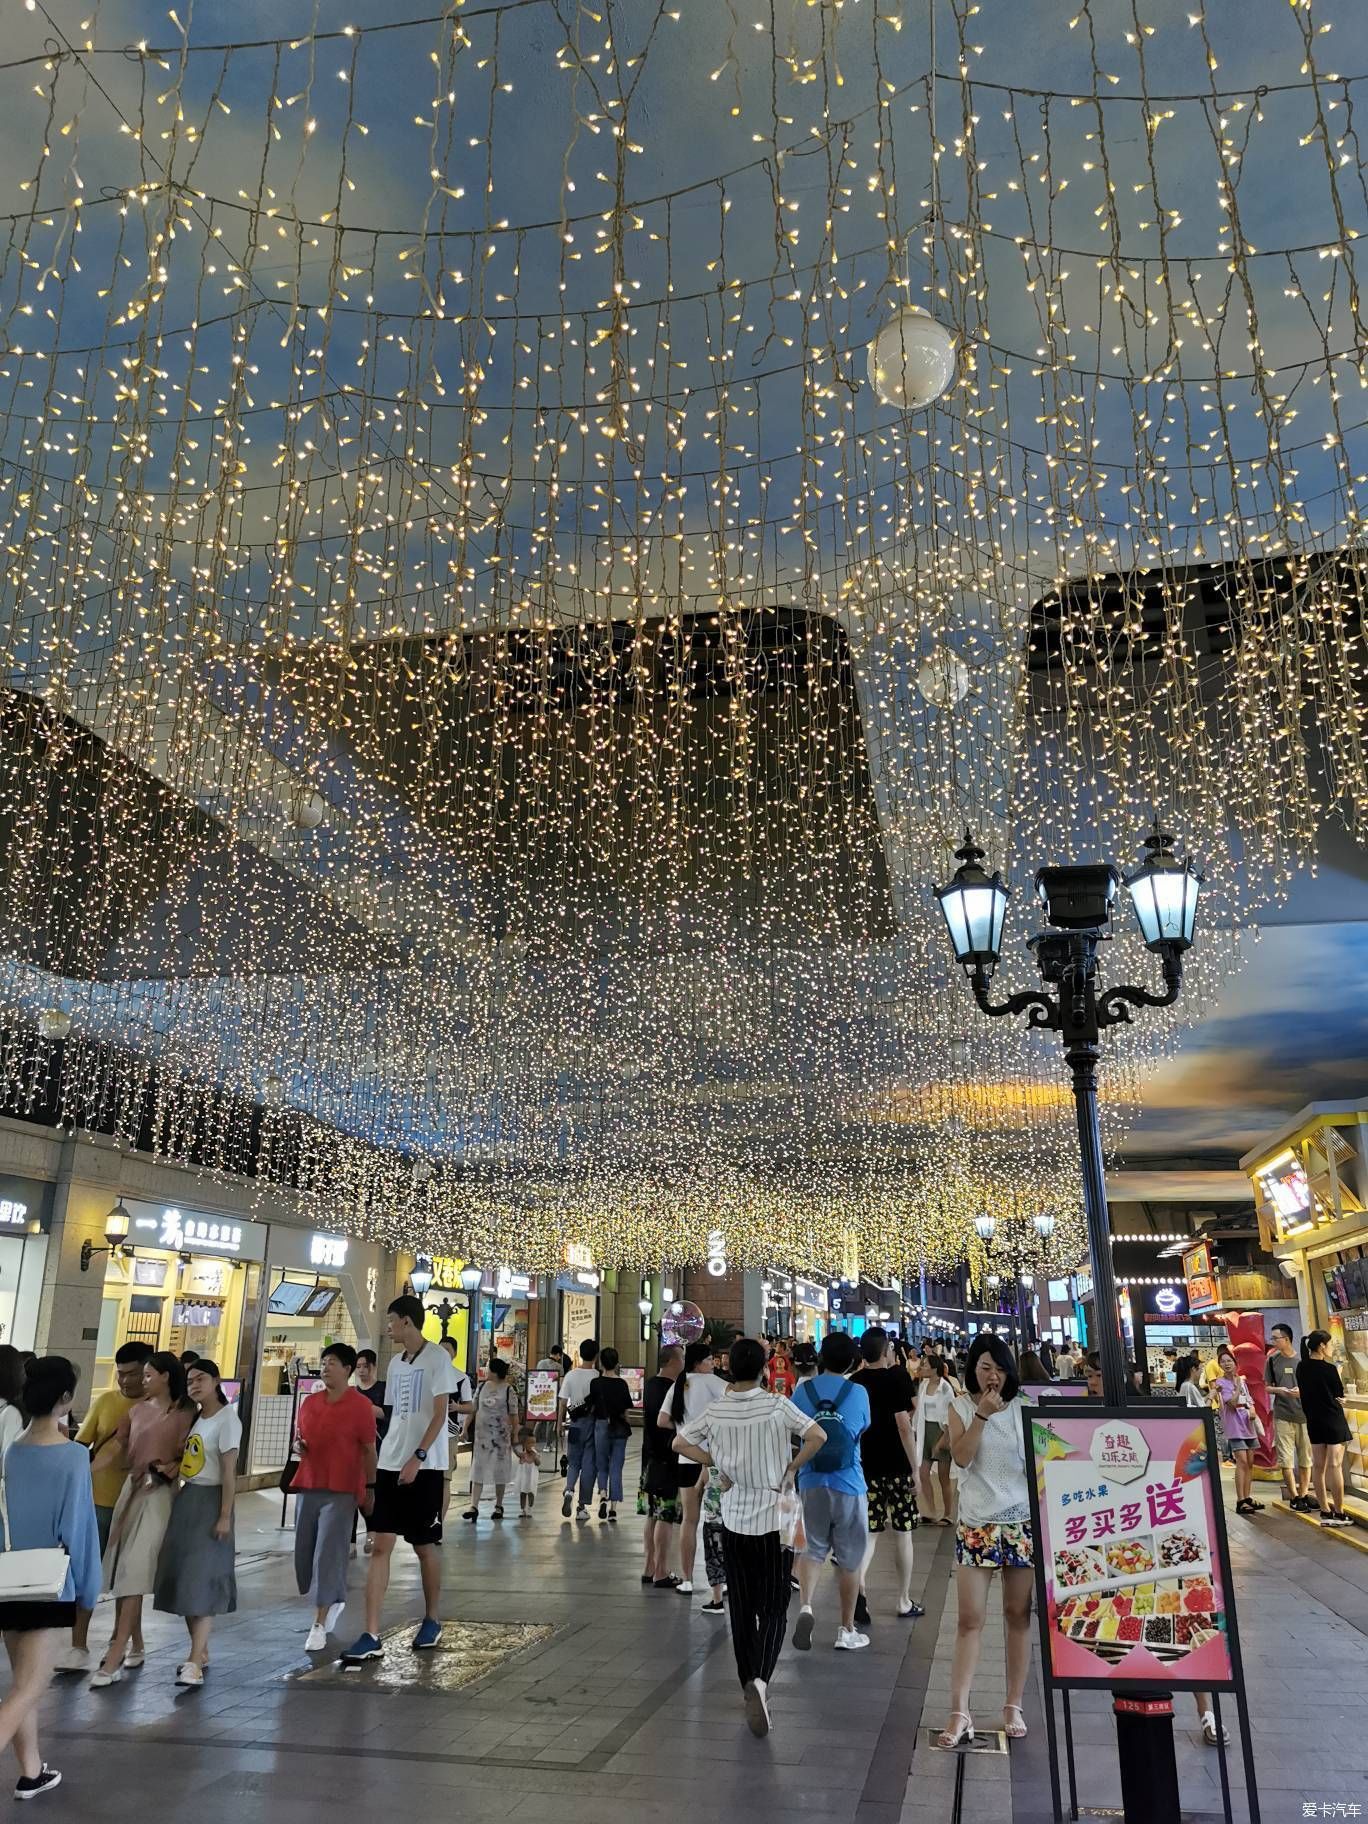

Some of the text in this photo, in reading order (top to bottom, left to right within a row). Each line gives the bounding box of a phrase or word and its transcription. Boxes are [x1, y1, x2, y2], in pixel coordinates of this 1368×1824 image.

[832, 1299, 842, 1310] 5
[1104, 1434, 1133, 1450] 奇趣
[1061, 1484, 1109, 1506] 多吃水果
[1065, 1477, 1187, 1545] 多买多送
[1123, 1701, 1140, 1711] 125
